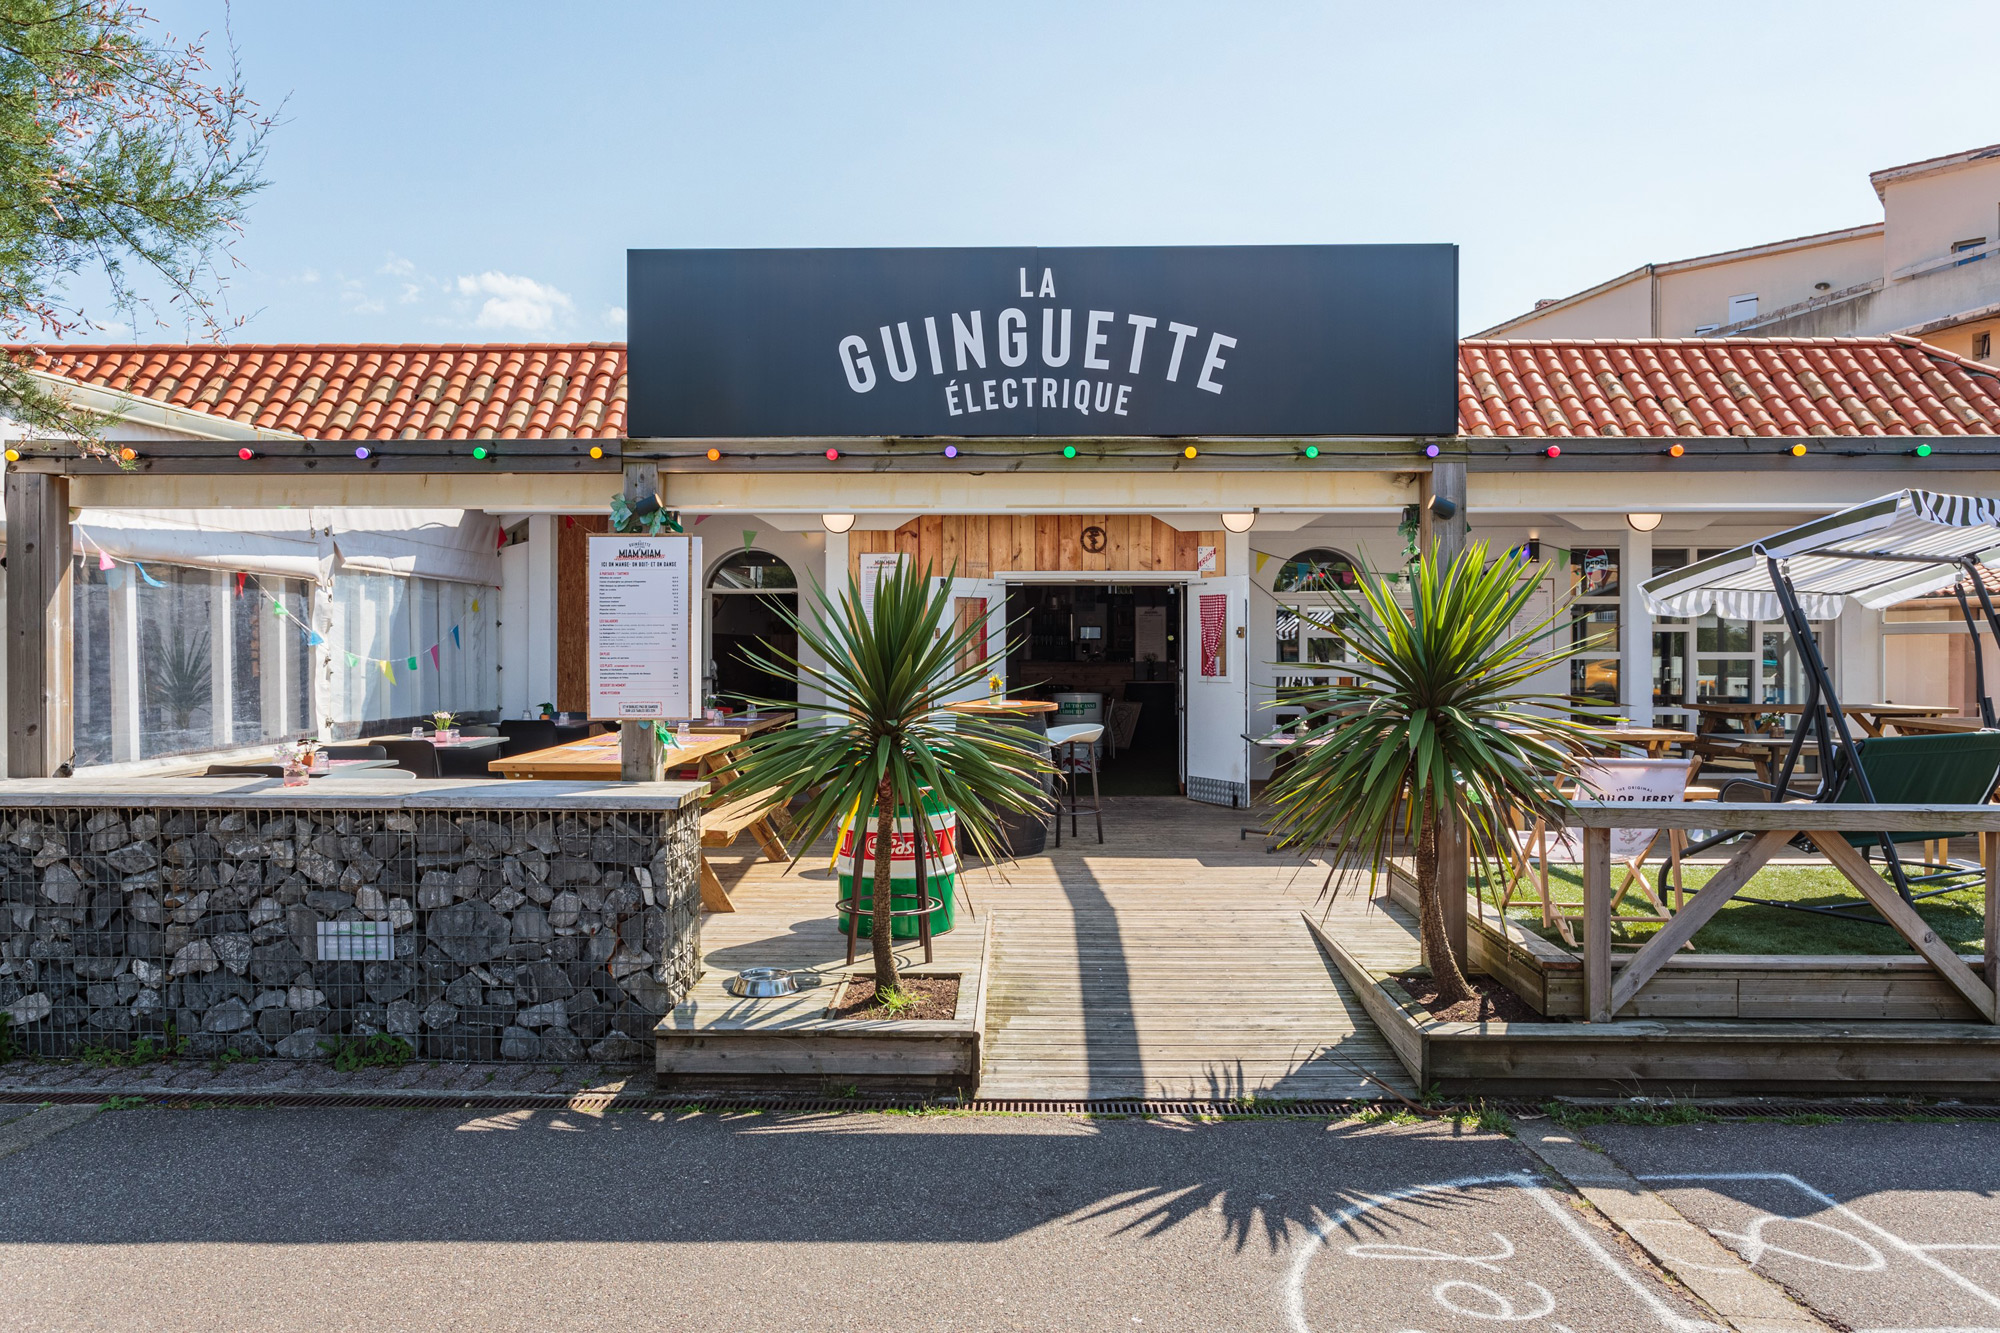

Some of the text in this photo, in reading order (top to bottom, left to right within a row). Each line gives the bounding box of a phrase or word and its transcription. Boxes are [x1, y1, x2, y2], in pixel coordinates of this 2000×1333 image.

[1019, 267, 1056, 298] LA
[838, 307, 1238, 395] GUINGUETTE
[944, 378, 1132, 417] ÉLECTRIQUE
[618, 548, 661, 558] MIAM'MIAM
[1586, 560, 1607, 568] PEPSI
